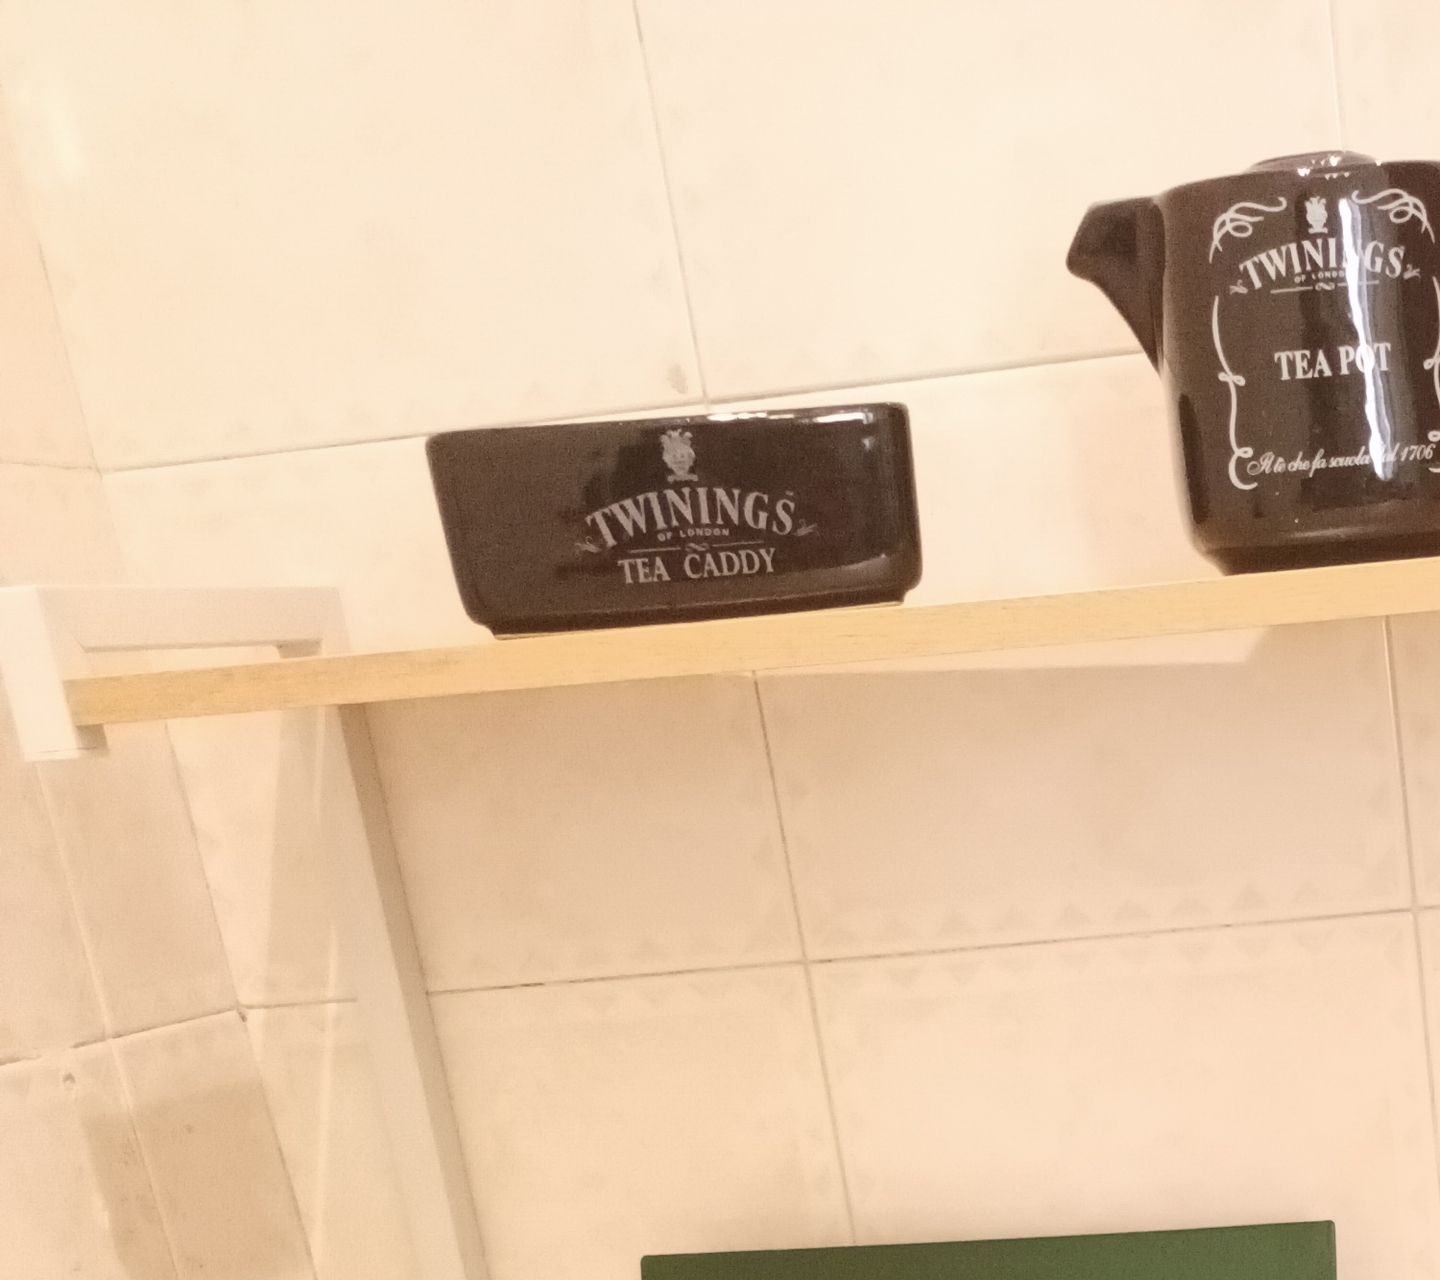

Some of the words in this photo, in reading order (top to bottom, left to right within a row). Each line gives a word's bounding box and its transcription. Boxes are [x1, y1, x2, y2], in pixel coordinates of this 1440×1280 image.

[1294, 275, 1306, 284] OF
[1312, 271, 1351, 280] LONDO
[1274, 349, 1332, 381] TEA
[1338, 342, 1391, 375] POT
[1287, 451, 1310, 472] che
[1309, 448, 1327, 478] fa
[1328, 445, 1370, 468] scuola
[1375, 442, 1400, 464] al
[1400, 443, 1437, 462] 1706
[584, 487, 796, 549] TWININGS
[656, 531, 673, 542] OF
[679, 528, 730, 538] LONDON
[617, 555, 672, 585] TEA
[683, 547, 776, 580] CADDY
